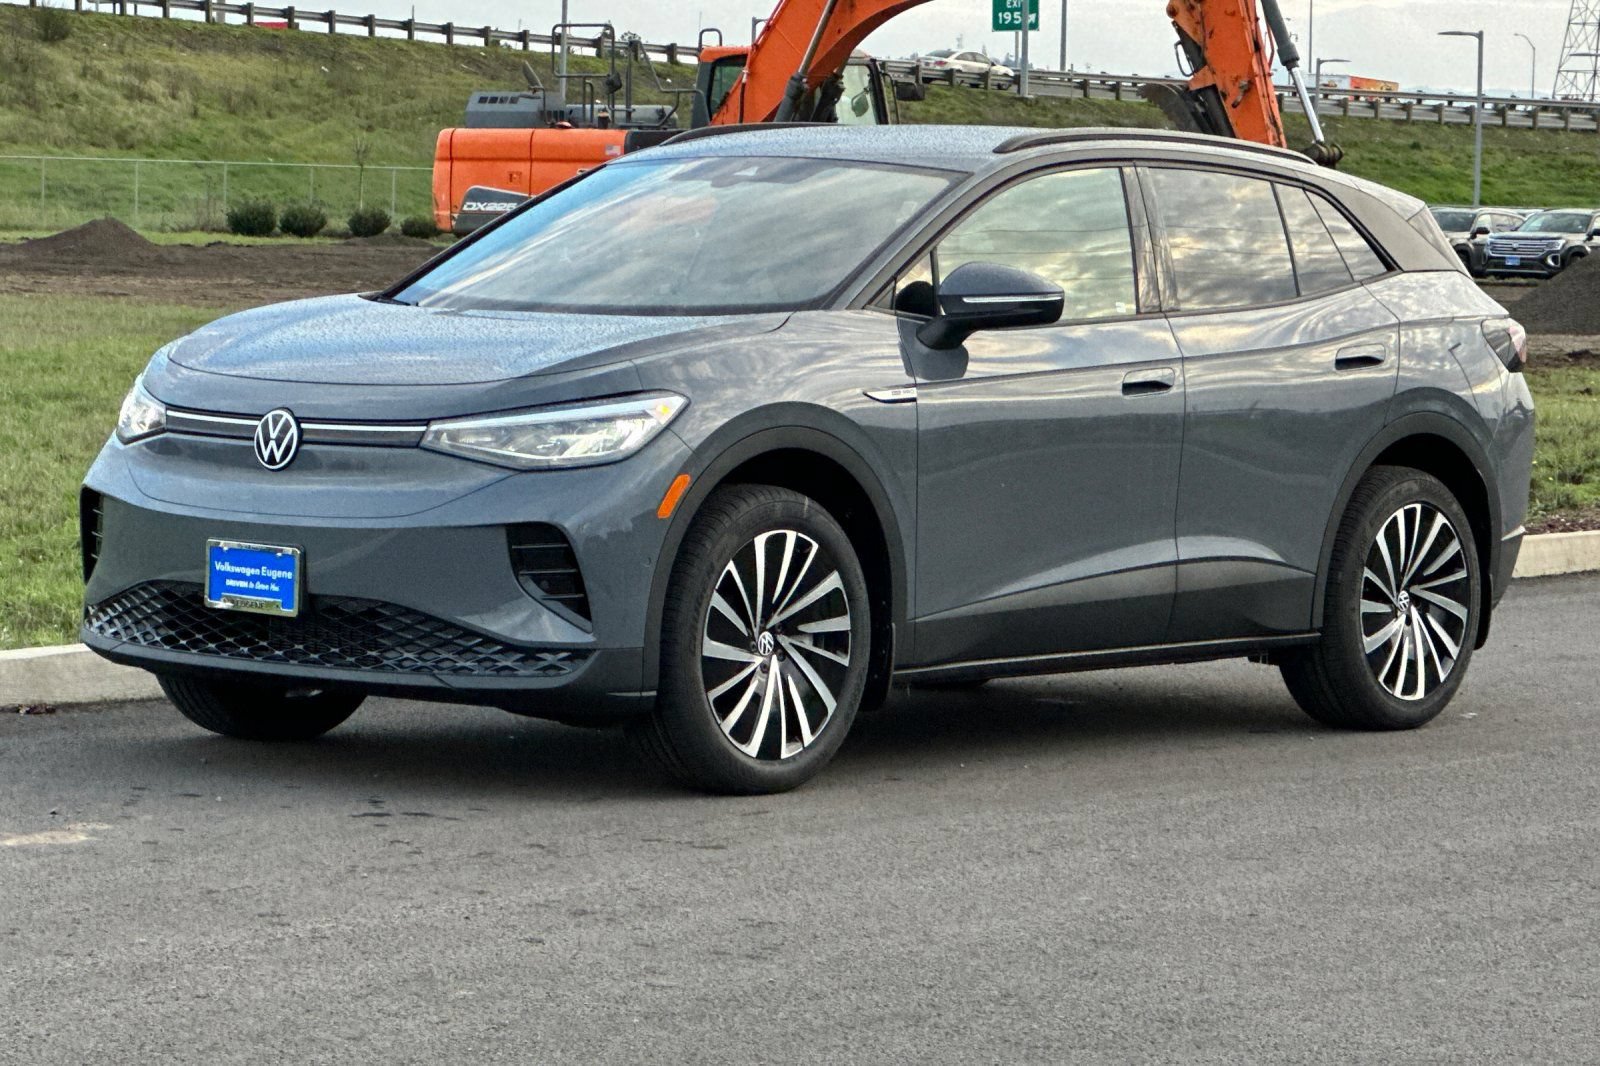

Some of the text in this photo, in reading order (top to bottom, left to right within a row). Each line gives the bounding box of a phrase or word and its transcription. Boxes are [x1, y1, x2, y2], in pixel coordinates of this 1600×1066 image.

[1006, 0, 1023, 8] EXI
[998, 12, 1022, 24] 195
[215, 561, 292, 579] Volkswagen Eugene
